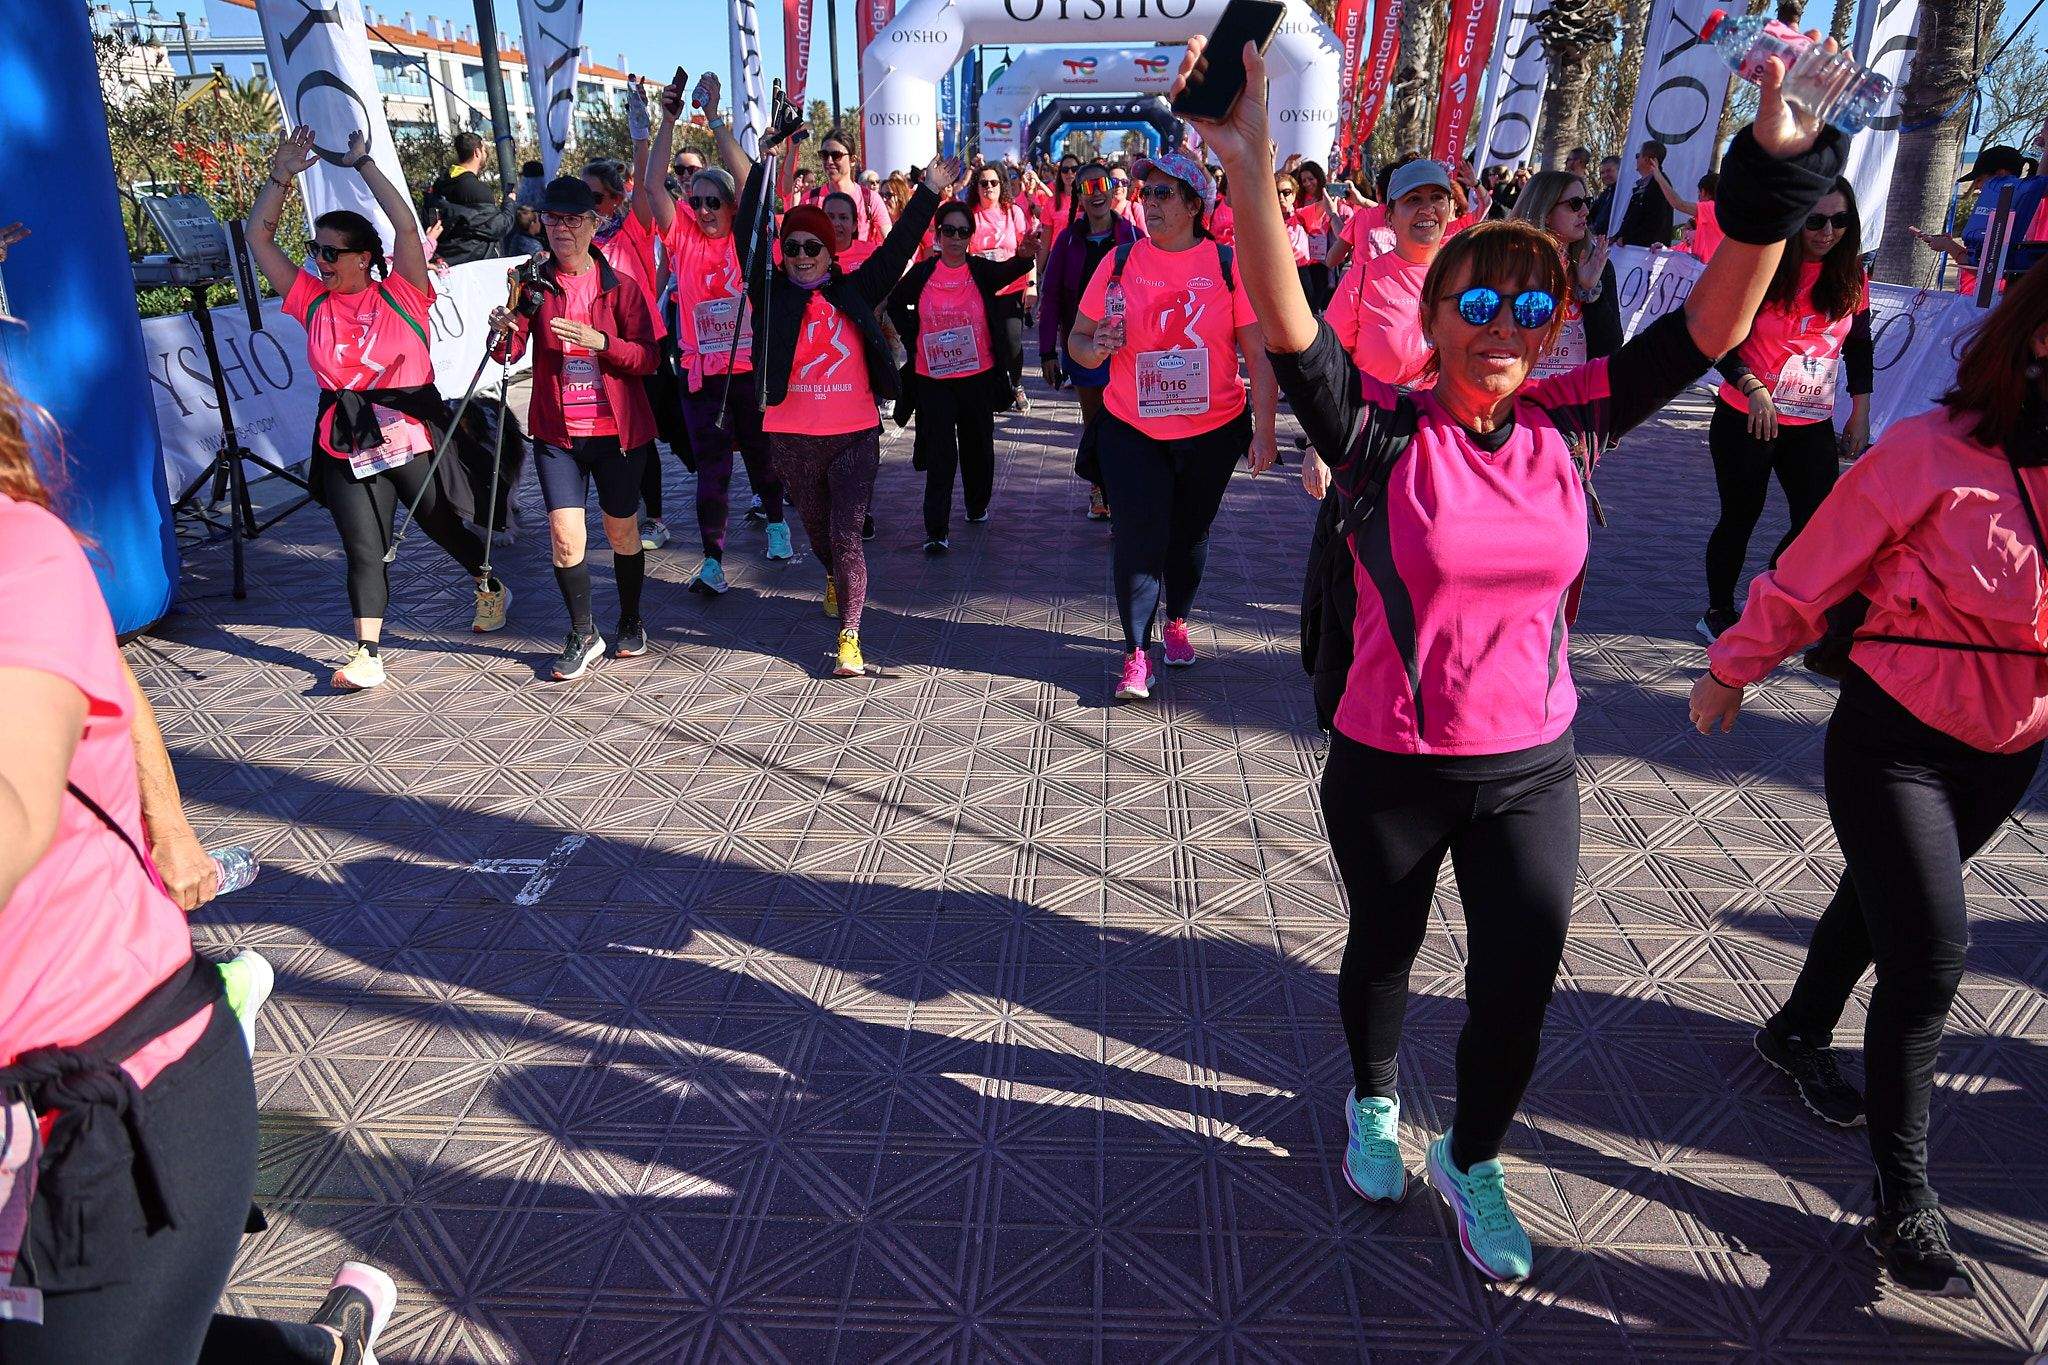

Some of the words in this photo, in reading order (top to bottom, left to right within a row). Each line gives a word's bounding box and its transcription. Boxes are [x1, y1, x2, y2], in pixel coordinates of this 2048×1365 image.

[891, 29, 948, 43] OYSHO
[1069, 105, 1142, 114] VOLVO
[869, 113, 920, 126] OYSHO
[1279, 109, 1333, 122] OYSHO
[1135, 276, 1165, 288] OYSHO
[714, 321, 736, 332] 016
[943, 348, 962, 358] 016
[823, 384, 831, 392] LA
[832, 383, 852, 392] MUJER
[1160, 380, 1187, 391] 016
[1799, 385, 1822, 396] 016
